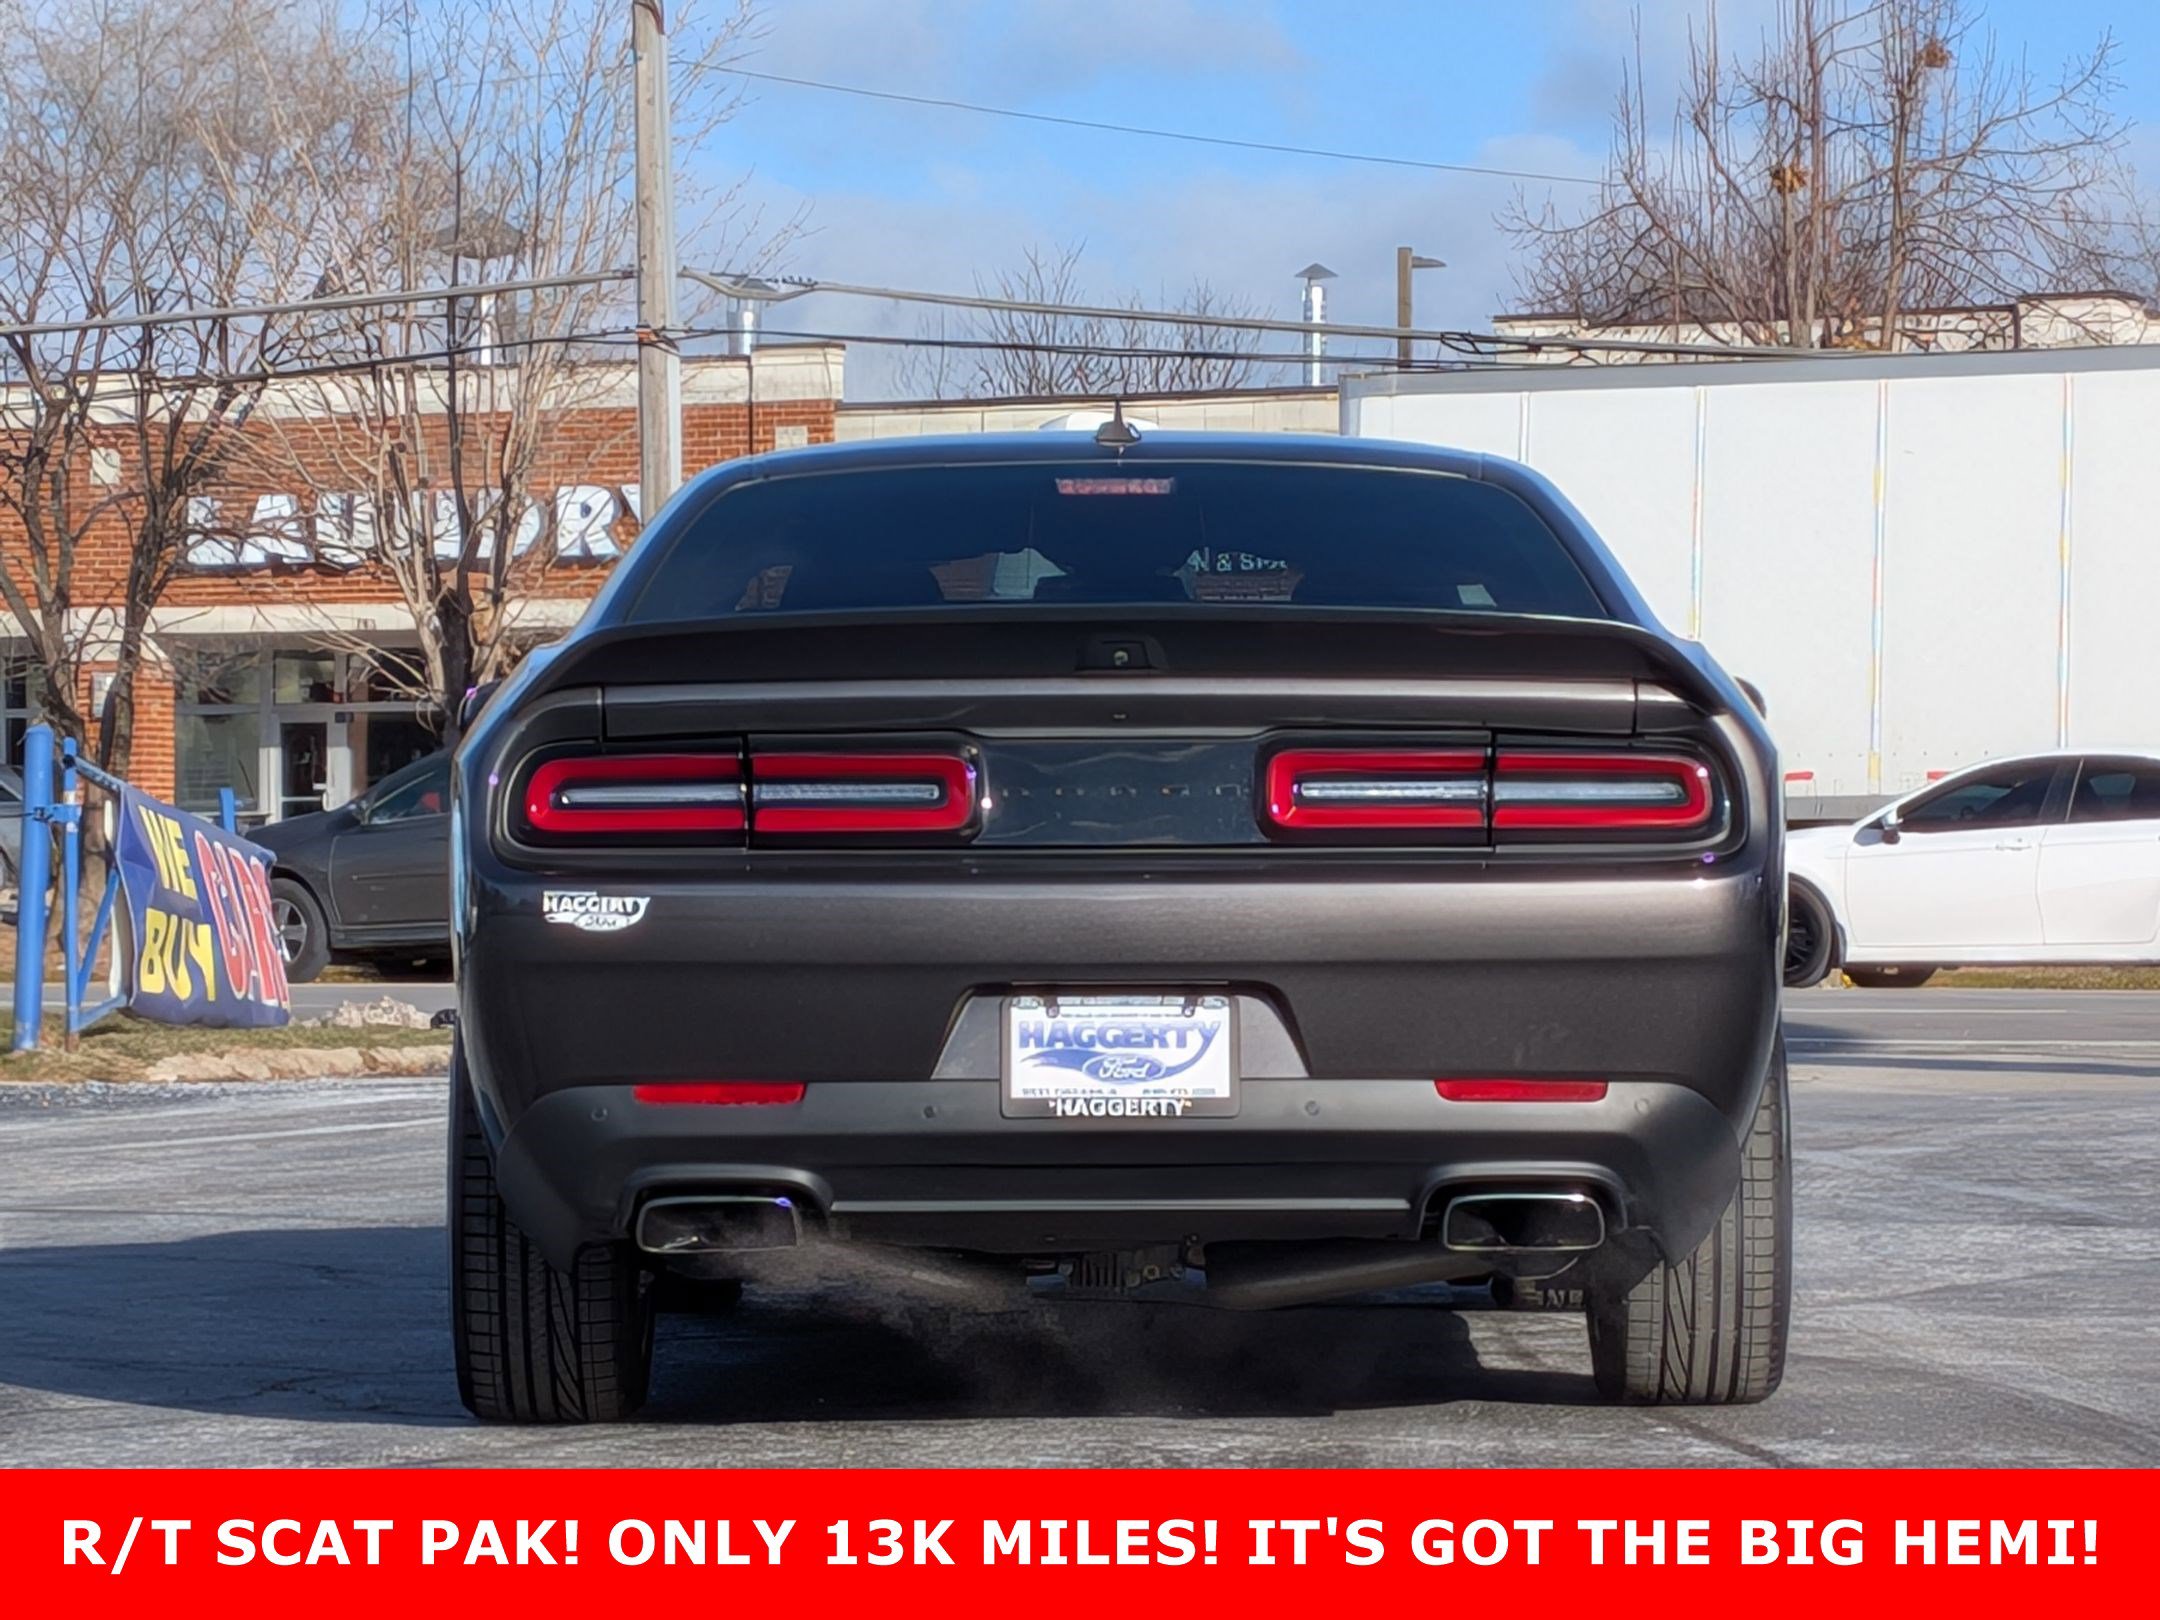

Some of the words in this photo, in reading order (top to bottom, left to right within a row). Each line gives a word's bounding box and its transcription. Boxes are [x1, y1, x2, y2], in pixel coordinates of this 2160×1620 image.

[138, 804, 198, 901] WE
[139, 907, 216, 1001] BUY
[1018, 1020, 1221, 1050] HAGGERTY
[1099, 1055, 1151, 1079] Ford
[1055, 1098, 1186, 1117] HAGGERTY
